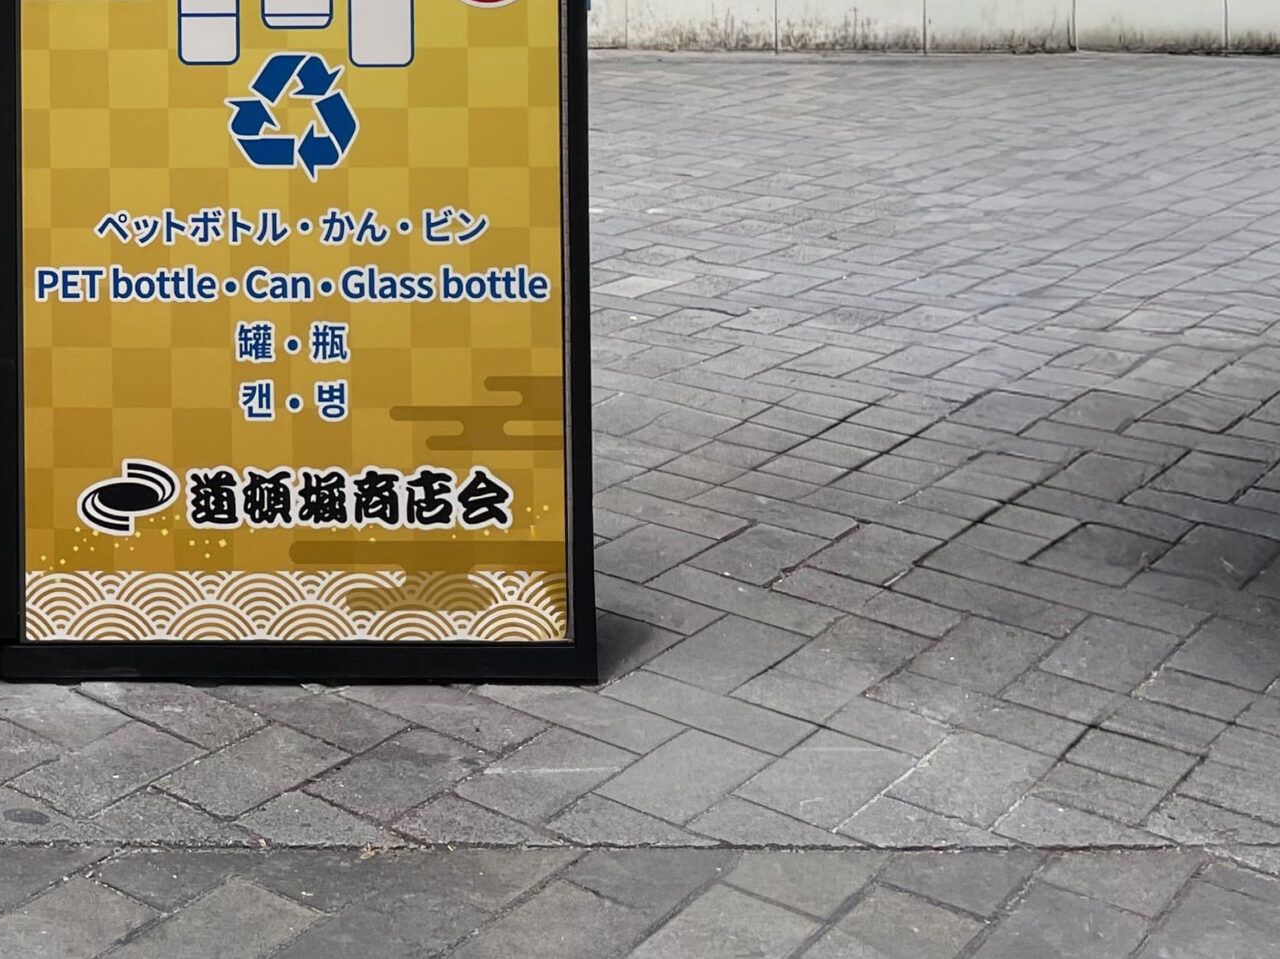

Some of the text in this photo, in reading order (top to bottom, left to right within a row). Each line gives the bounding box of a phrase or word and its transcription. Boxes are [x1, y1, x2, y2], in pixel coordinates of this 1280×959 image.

[98, 209, 486, 244] ペットボトル・かん・ビン
[38, 269, 104, 299] PET
[443, 268, 548, 299] bottle
[190, 470, 510, 526] 道頓堀商店会
